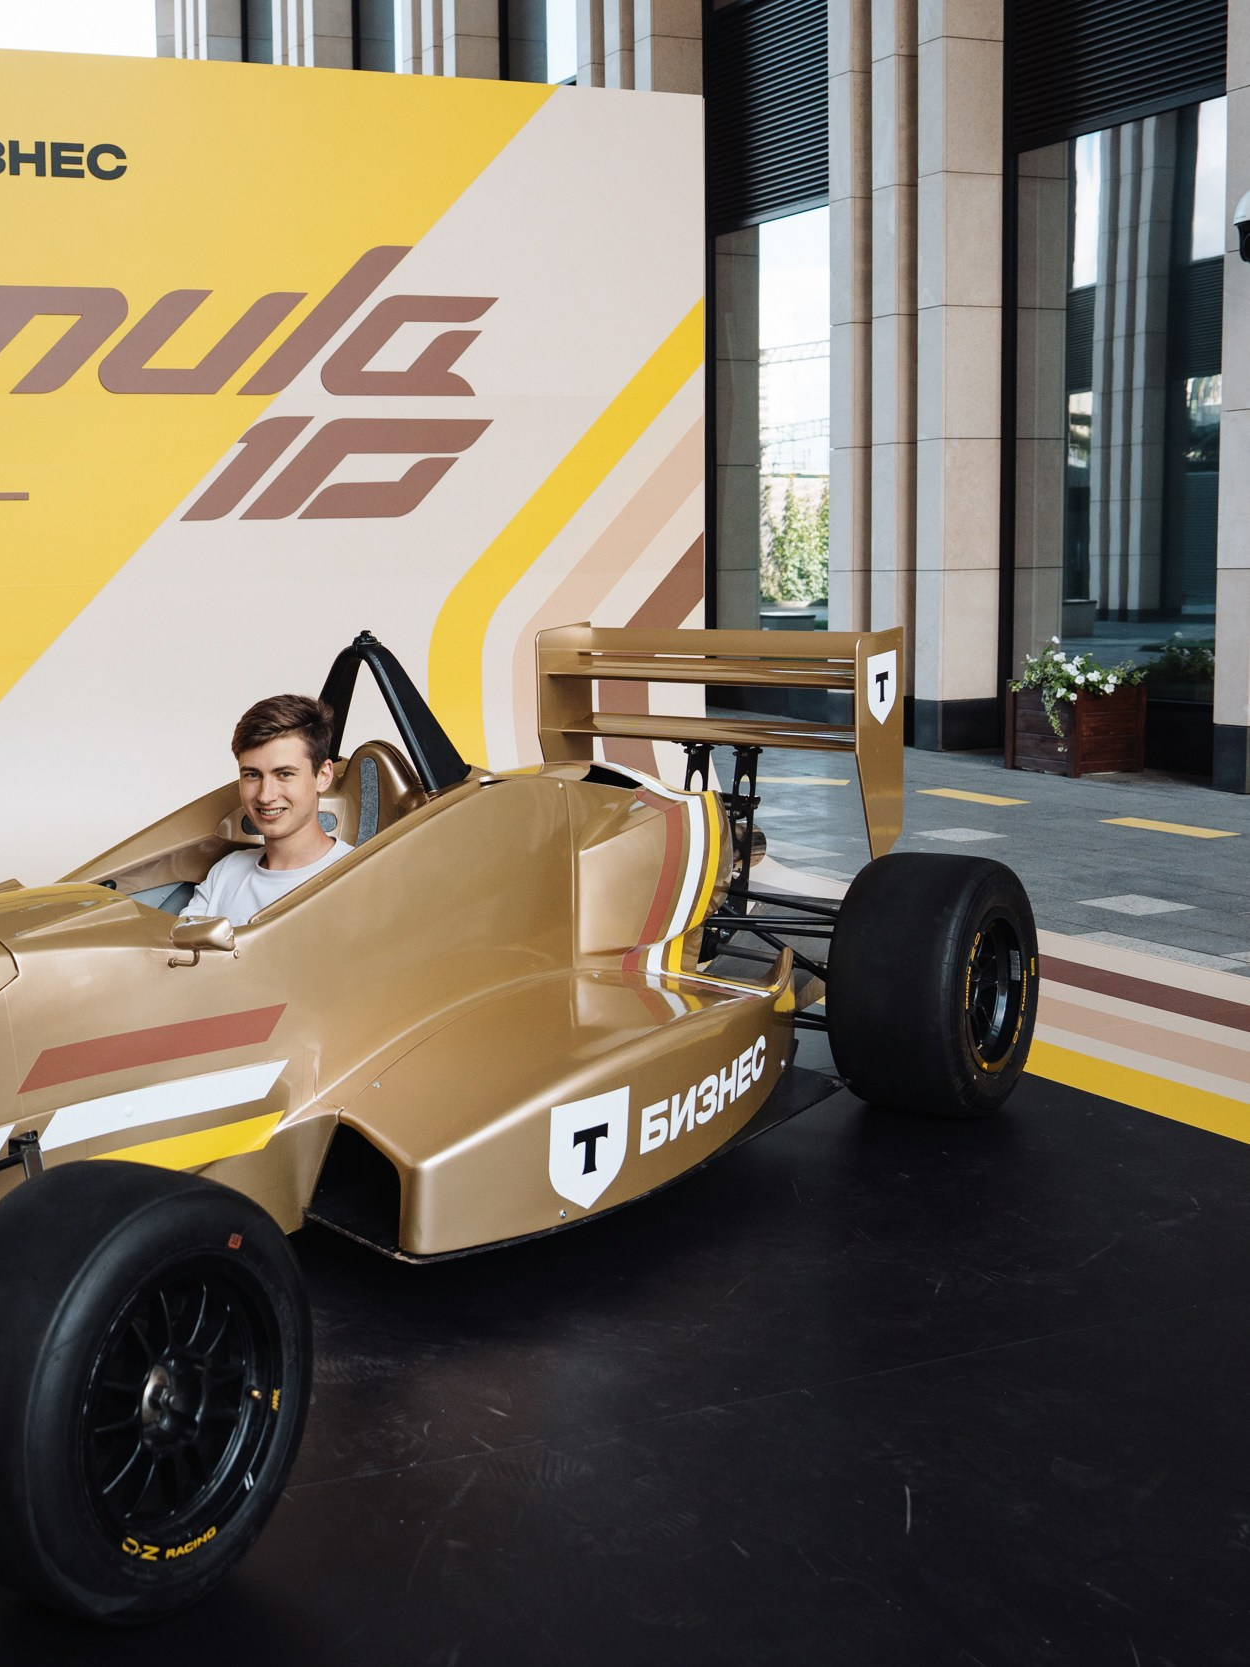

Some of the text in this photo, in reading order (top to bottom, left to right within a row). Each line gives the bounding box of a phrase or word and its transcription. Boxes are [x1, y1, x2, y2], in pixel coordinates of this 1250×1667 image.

[180, 416, 495, 522] 10
[639, 1035, 766, 1155] БИЗНЕС
[165, 1526, 217, 1560] RACING
